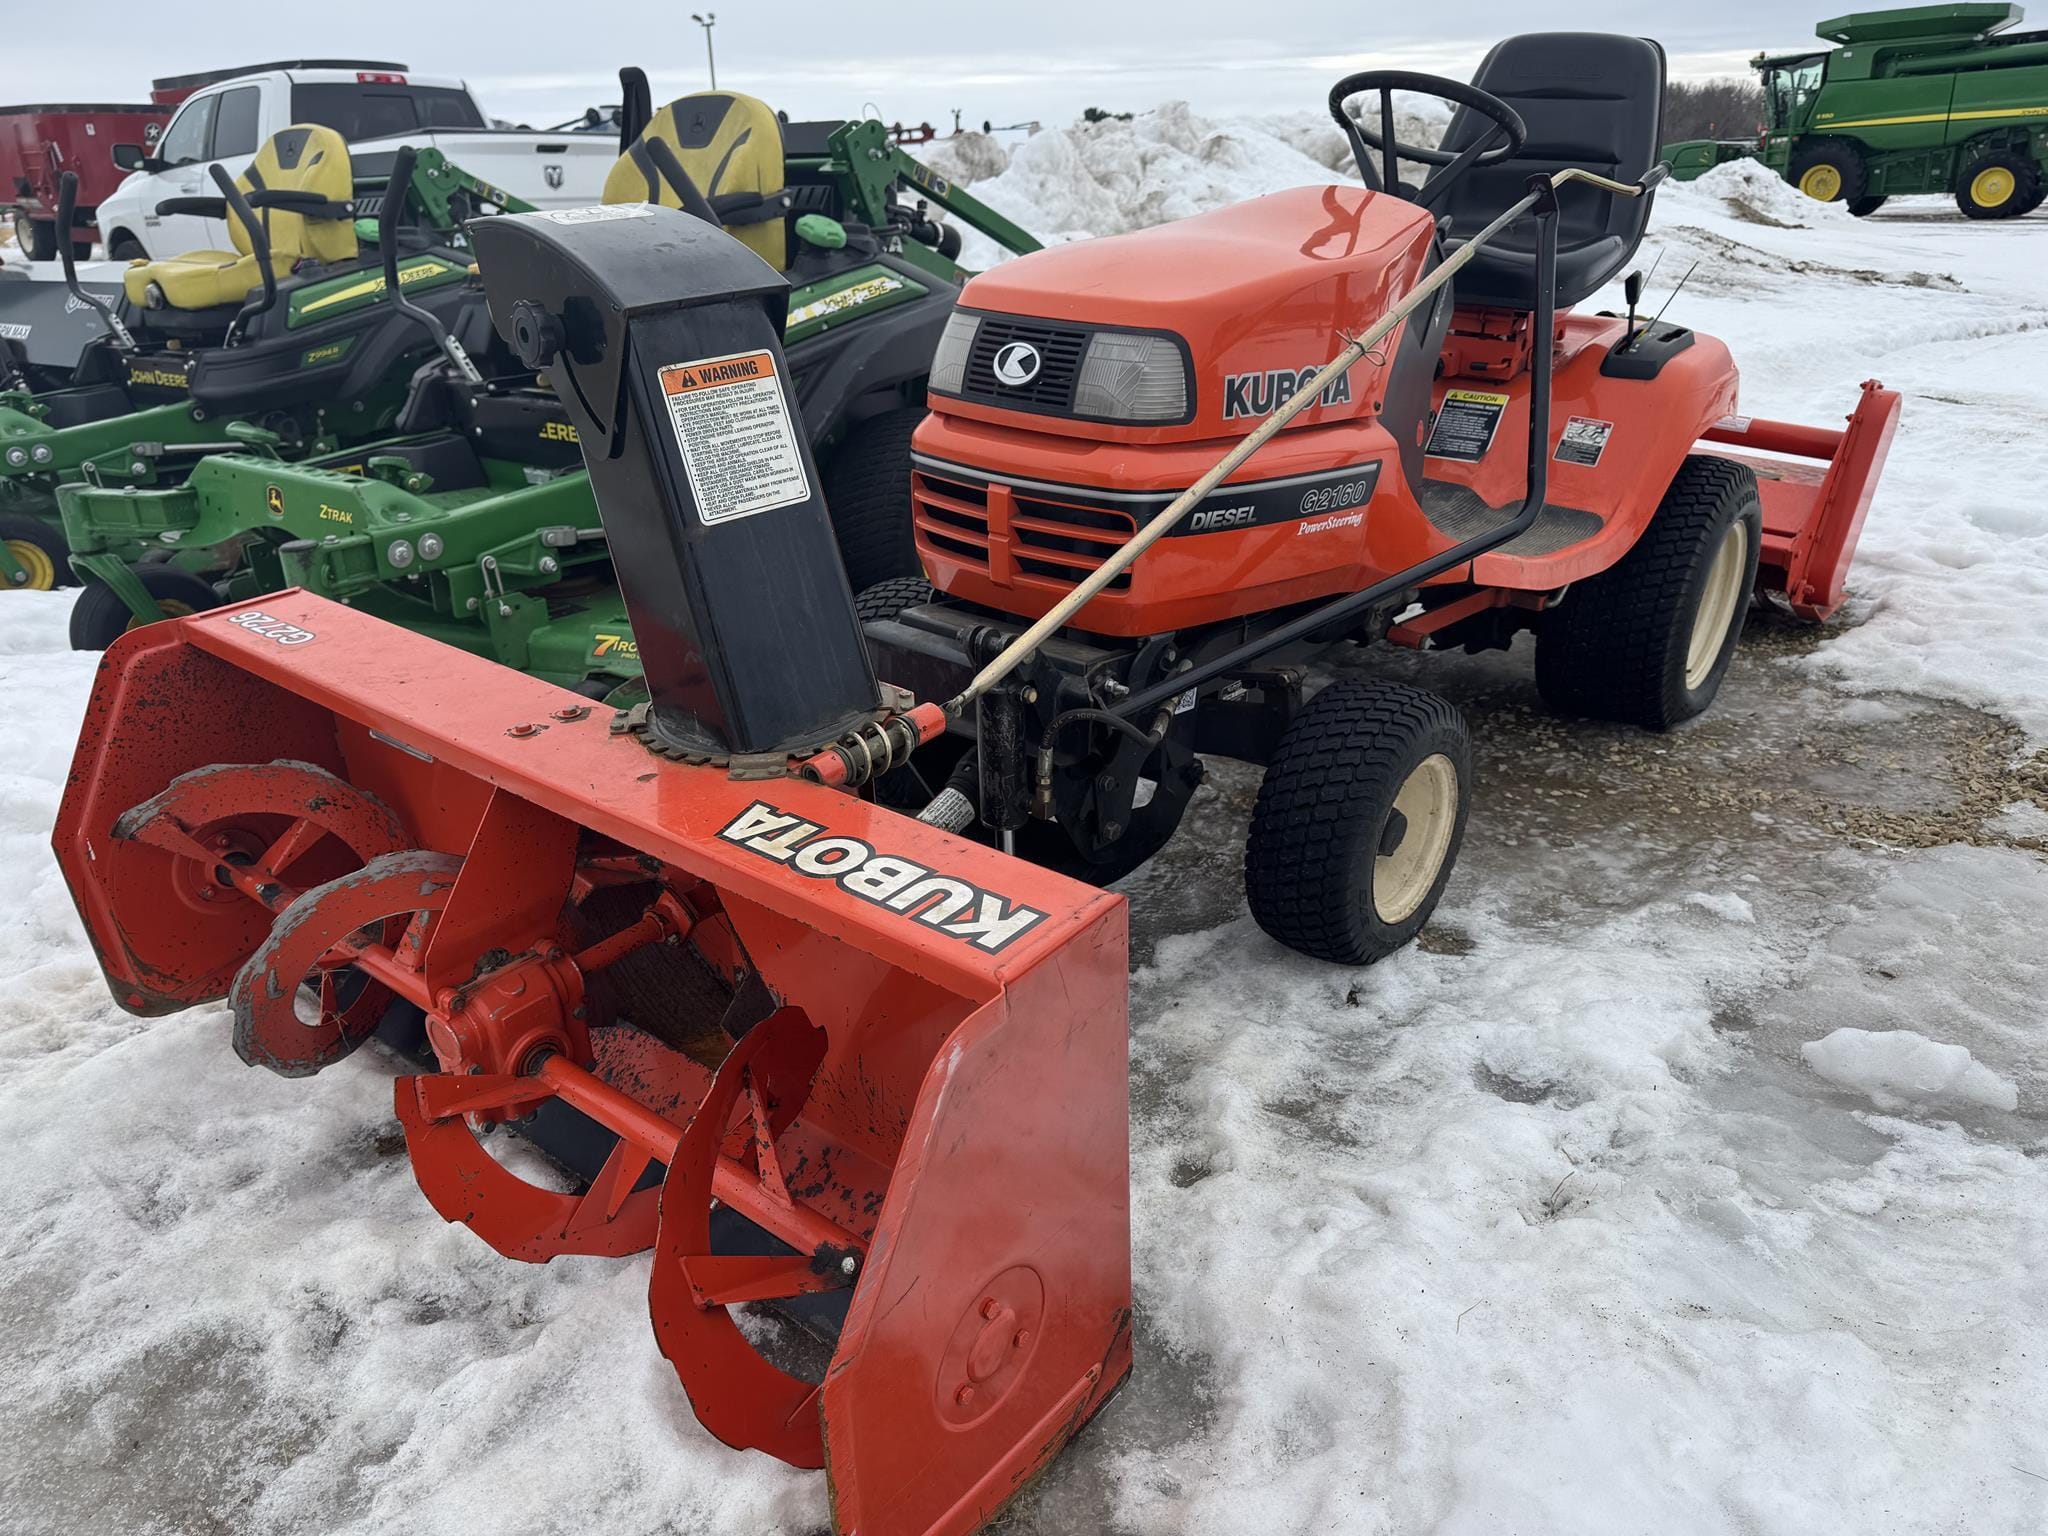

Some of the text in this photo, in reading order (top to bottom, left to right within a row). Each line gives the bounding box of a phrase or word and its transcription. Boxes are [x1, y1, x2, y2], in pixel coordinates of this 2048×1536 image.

[698, 360, 758, 384] WARNING
[130, 367, 189, 388] JOHN DEERE
[671, 394, 691, 402] FAILURE
[731, 382, 756, 390] OPERATING
[672, 397, 705, 406] PROCEDURES
[700, 400, 725, 408] OPERATION
[752, 390, 775, 398] OPERATING
[1463, 393, 1498, 403] CAUTION
[679, 408, 711, 418] INSTRUCTIONS
[738, 397, 767, 406] PRECAUTIONS
[680, 414, 709, 423] OPERATOR'S
[691, 417, 719, 426] PROTECTION
[734, 414, 756, 422] CLOTHING
[734, 425, 752, 433] LEAVING
[752, 421, 774, 429] OPERATOR
[720, 437, 746, 446] MOVEMENTS
[691, 449, 712, 457] STARTING
[734, 450, 758, 458] OPERATION
[746, 458, 764, 466] SHIELDS
[695, 464, 716, 472] PERSONS
[729, 466, 752, 475] DISCHARGE
[716, 491, 734, 499] PLASTIC
[735, 485, 758, 494] MATERIALS
[738, 494, 765, 504] PASSENGERS
[1300, 481, 1367, 514] G2160
[1190, 506, 1256, 530] DIESEL
[227, 610, 317, 645] G2726
[714, 799, 1052, 956] KUBOTA
